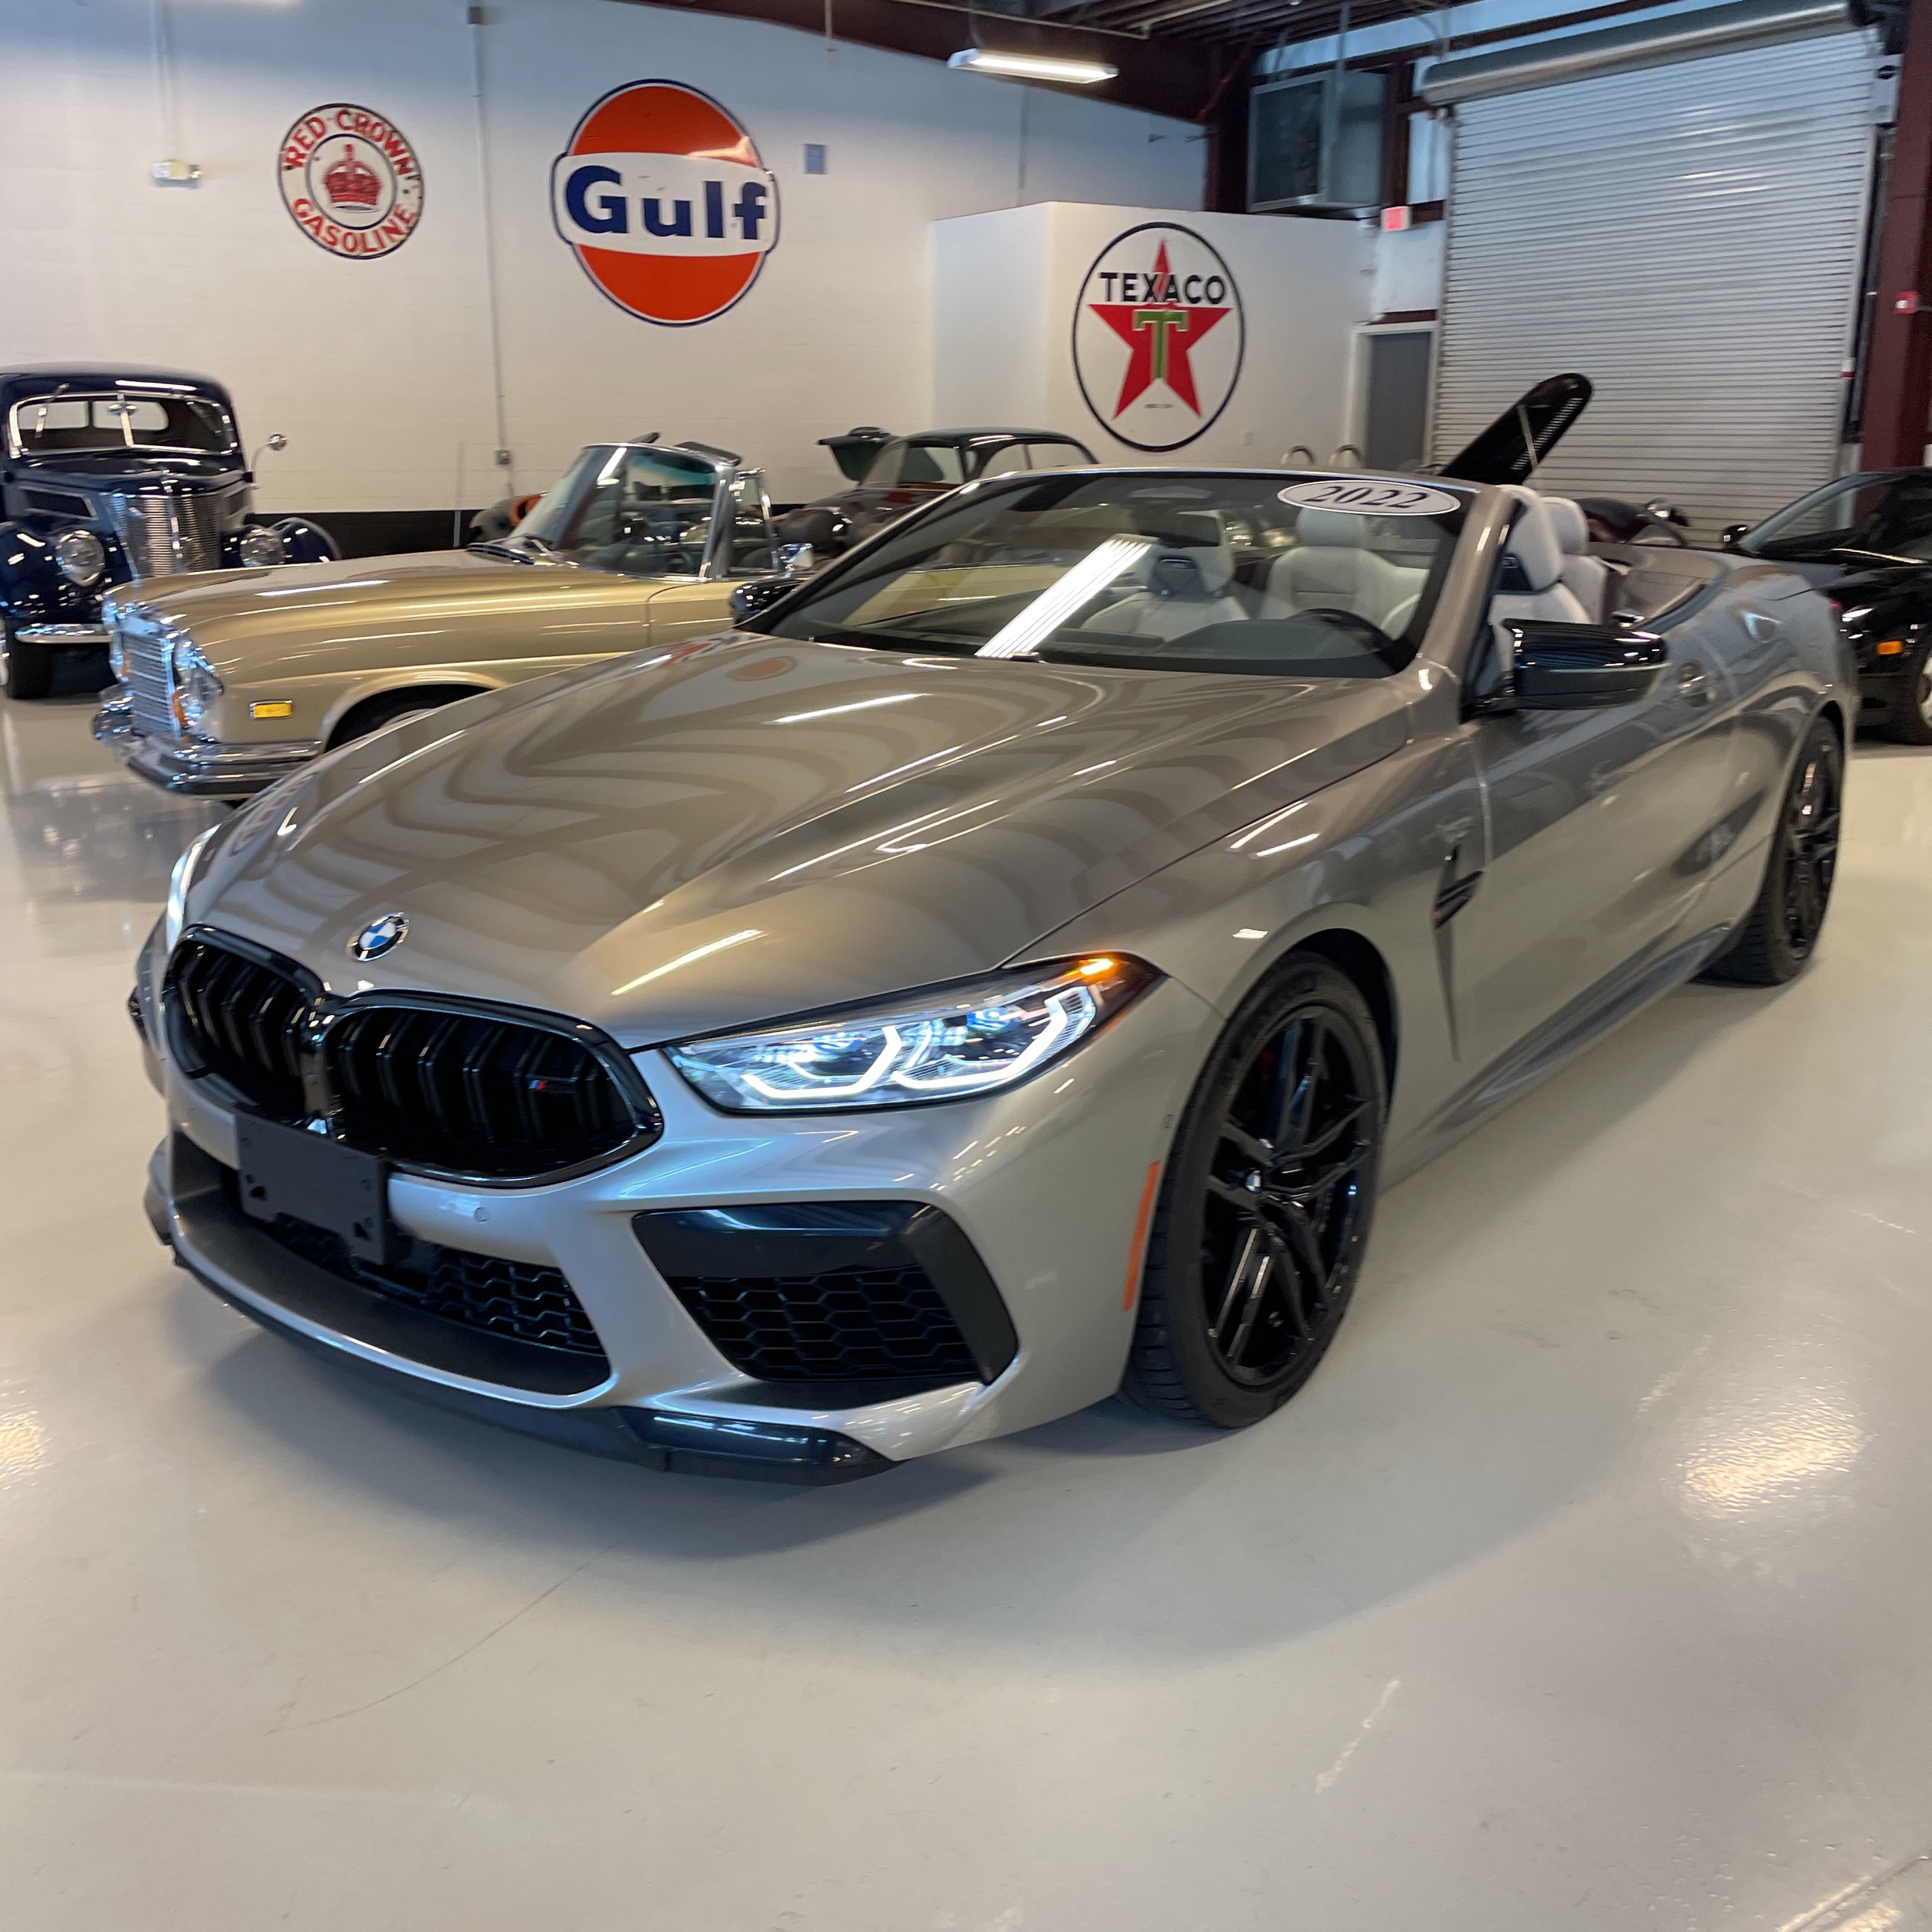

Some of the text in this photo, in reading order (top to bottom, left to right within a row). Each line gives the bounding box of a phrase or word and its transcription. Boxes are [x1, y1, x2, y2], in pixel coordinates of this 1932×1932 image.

[284, 110, 416, 175] RED CROWN
[294, 198, 417, 253] GASOLINE
[565, 165, 768, 240] Gulf
[1099, 272, 1226, 304] TEXACO
[1132, 310, 1190, 379] T
[1301, 486, 1430, 508] 2022
